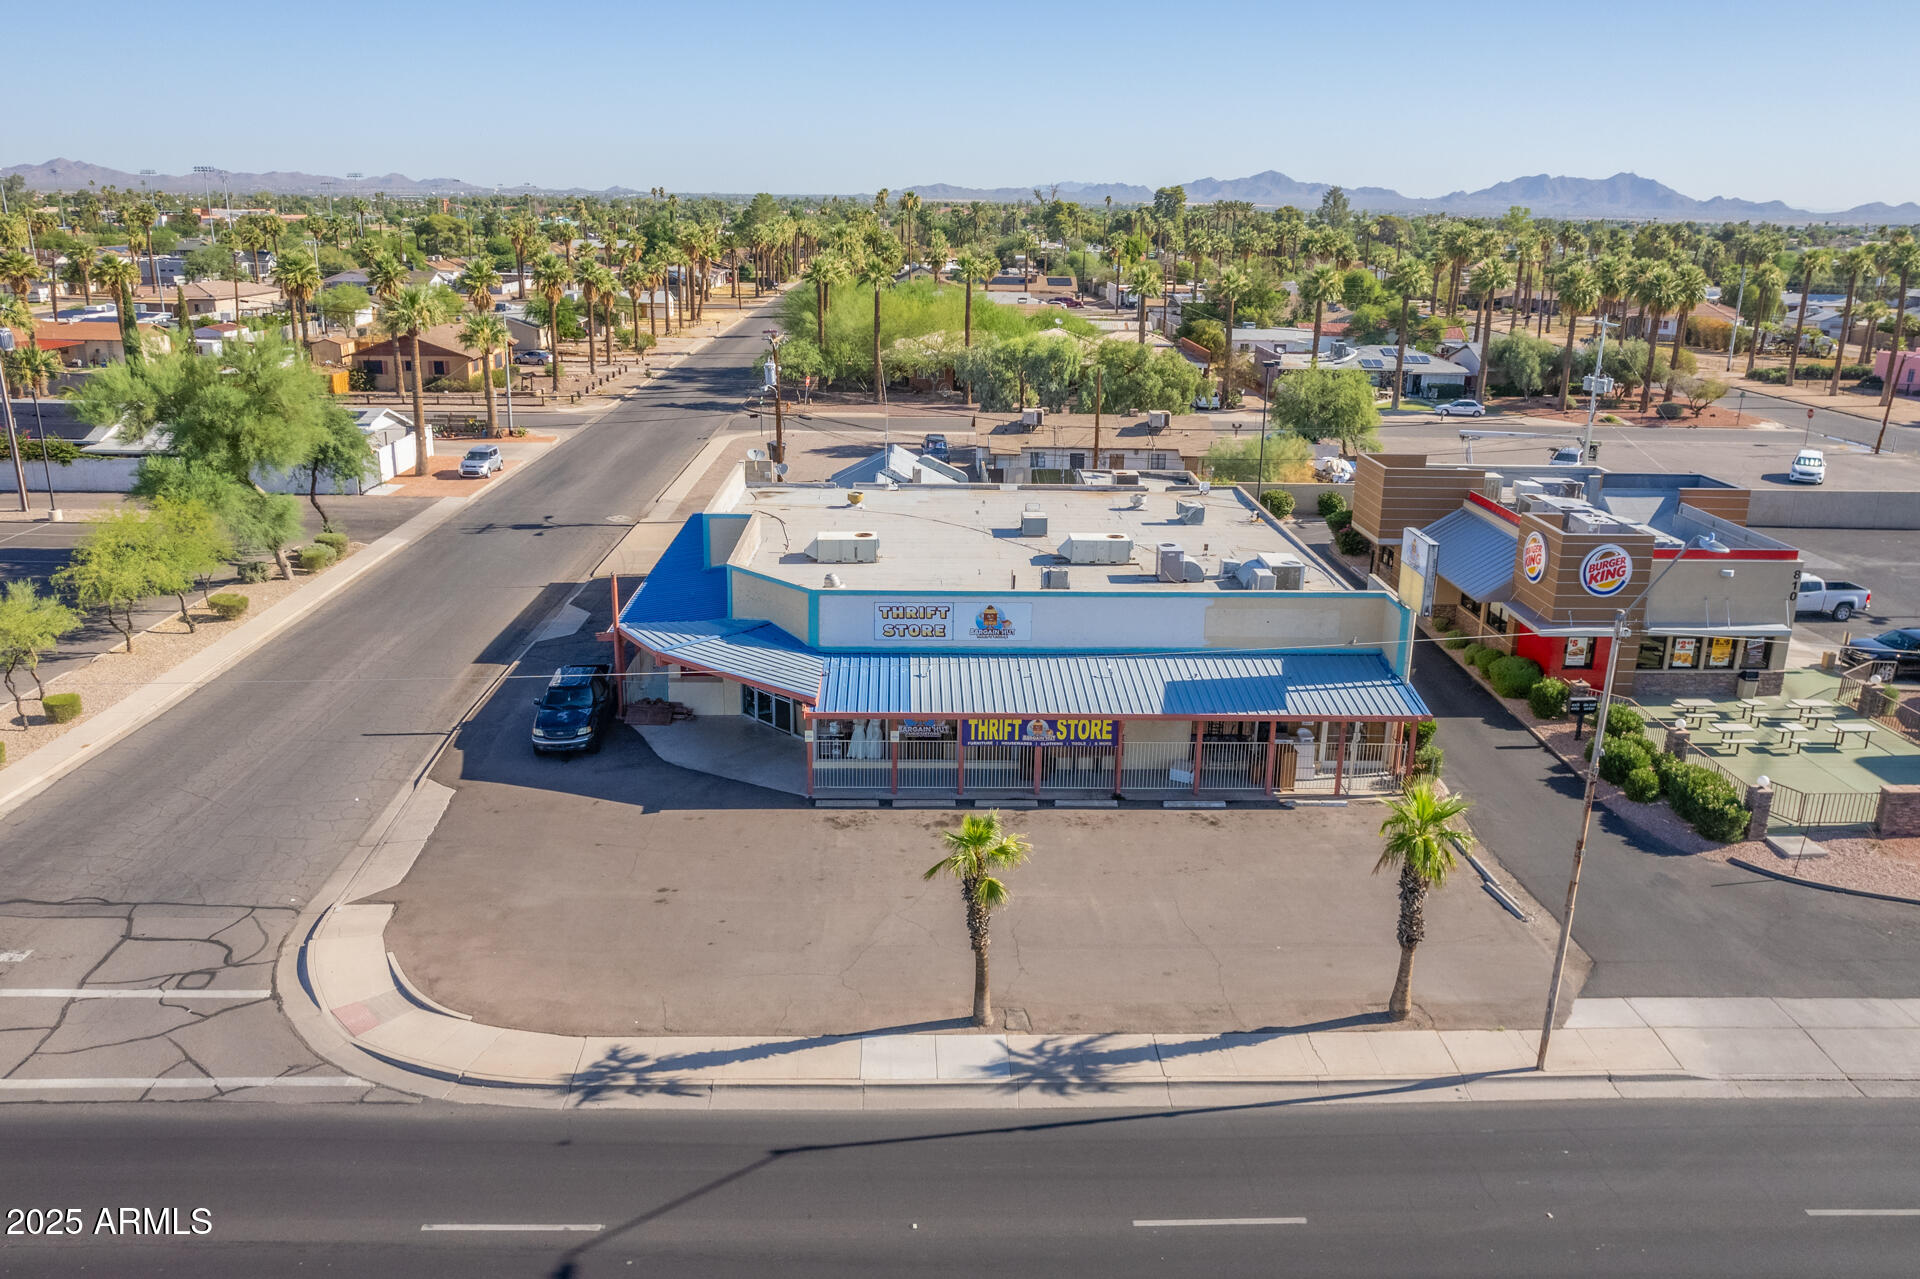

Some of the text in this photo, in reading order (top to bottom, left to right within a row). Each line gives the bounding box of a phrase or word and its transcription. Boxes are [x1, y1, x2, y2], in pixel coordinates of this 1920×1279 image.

[1525, 545, 1542, 555] BURGER
[1526, 553, 1542, 567] KING
[1588, 556, 1626, 573] BURGER
[1587, 566, 1627, 585] KING
[1790, 570, 1800, 601] 810
[879, 606, 950, 620] THRIFT
[883, 623, 946, 638] STORE
[968, 719, 1113, 740] THRIFT STORE
